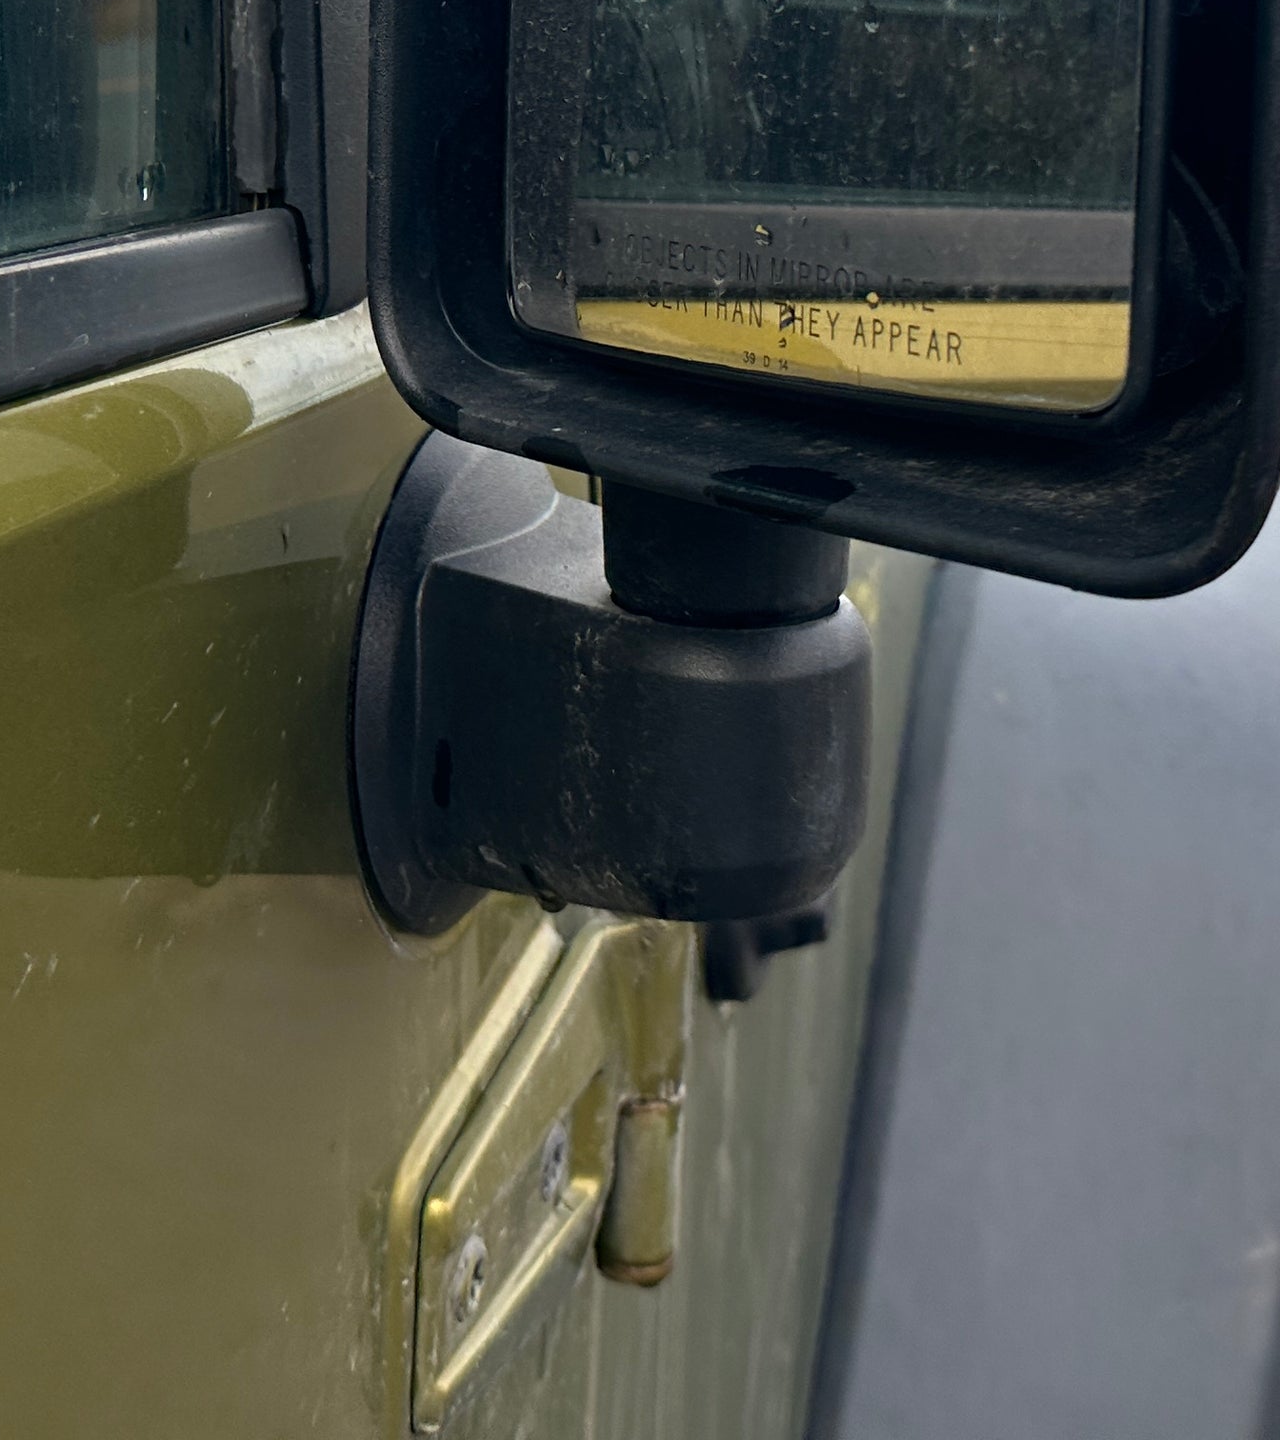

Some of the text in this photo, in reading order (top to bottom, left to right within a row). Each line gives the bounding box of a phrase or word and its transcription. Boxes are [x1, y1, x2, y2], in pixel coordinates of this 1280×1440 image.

[625, 233, 728, 279] OBJECTS
[737, 251, 760, 281] IN
[607, 271, 689, 313] OSER
[774, 301, 840, 341] THEY
[853, 315, 962, 366] APPEAR
